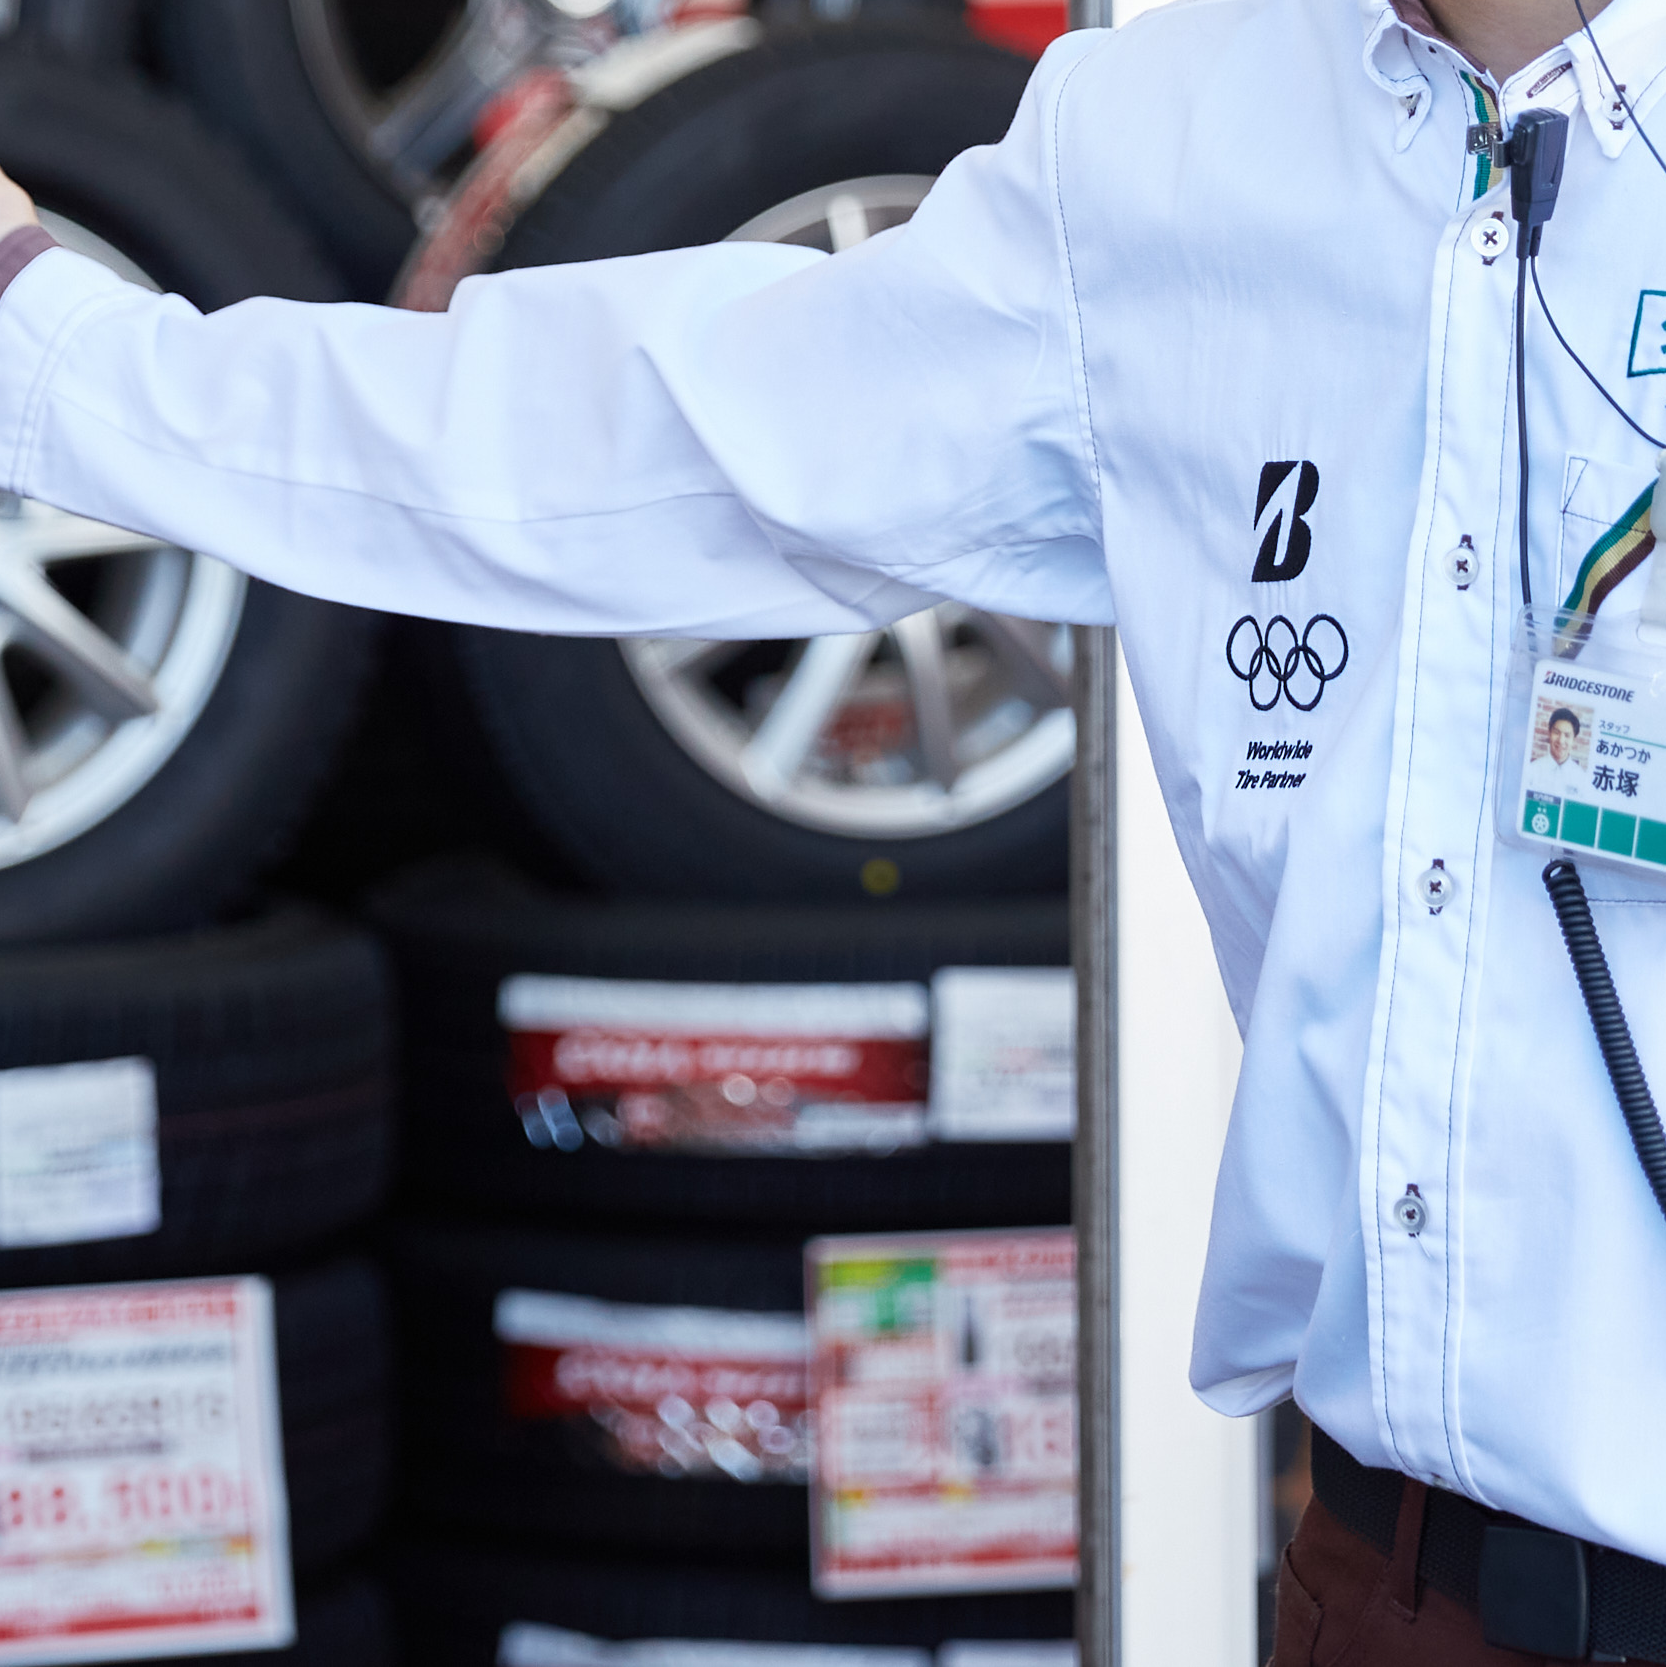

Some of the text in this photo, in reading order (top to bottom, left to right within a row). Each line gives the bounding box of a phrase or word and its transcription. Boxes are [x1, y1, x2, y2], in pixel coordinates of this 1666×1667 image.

[1543, 670, 1636, 703] BRIDGESTONE
[1598, 719, 1631, 734] スタッフ
[1246, 739, 1313, 760] Worldwide
[1595, 739, 1652, 764] あかつか
[1235, 769, 1307, 789] Tire Partner
[1591, 764, 1641, 799] 赤塚
